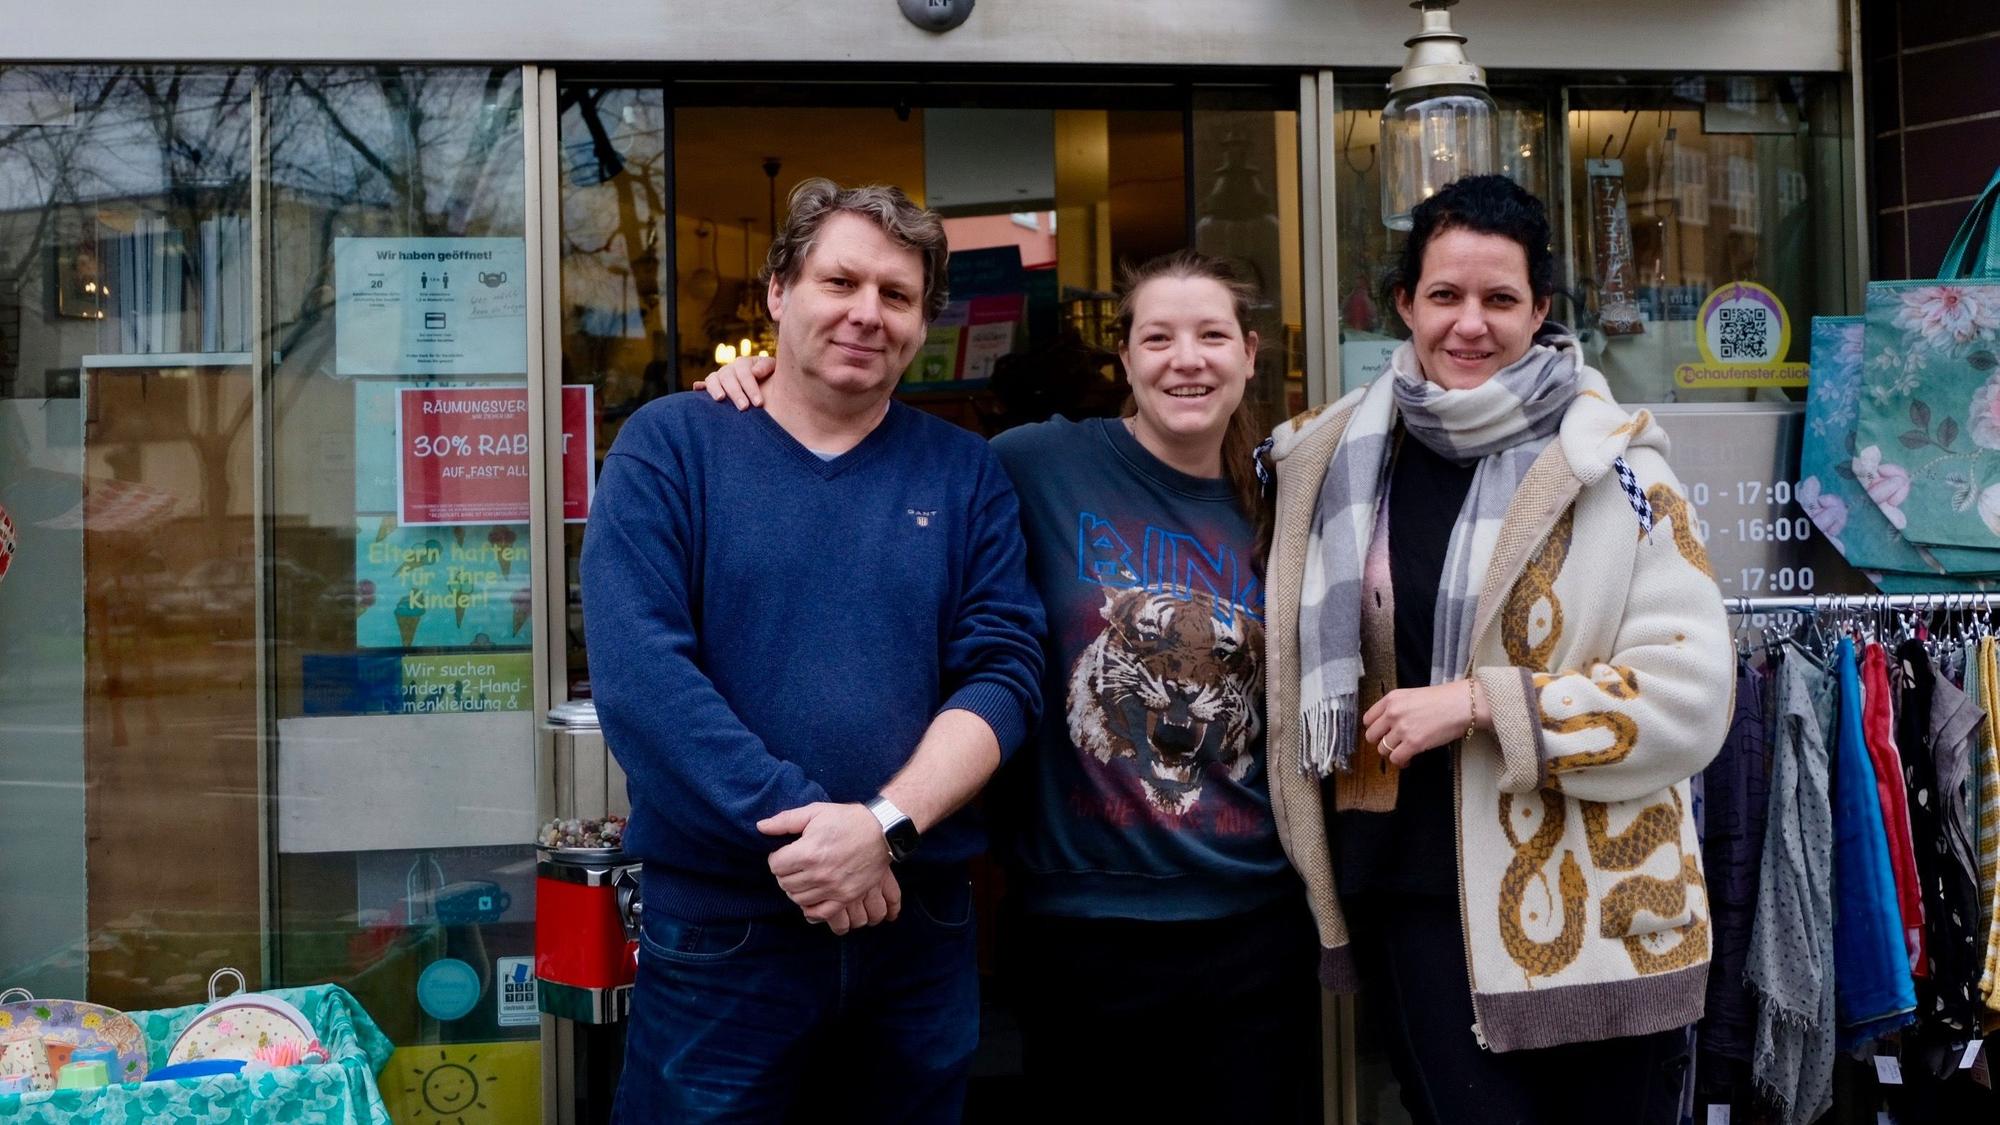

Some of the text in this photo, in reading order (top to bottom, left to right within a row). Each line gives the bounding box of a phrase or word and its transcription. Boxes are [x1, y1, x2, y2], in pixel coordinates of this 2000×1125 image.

[376, 249, 493, 262] Wir haben geöffnet!
[370, 279, 383, 289] 20
[413, 433, 574, 457] 30% RABT
[442, 466, 463, 478] AUF
[1737, 517, 1811, 542] 16:00
[369, 542, 529, 563] Eltern haften
[399, 565, 498, 587] für Ihre
[1740, 566, 1815, 592] 17:00
[409, 590, 488, 609] Kinder!
[404, 661, 496, 678] Wir suchen
[394, 677, 528, 696] ondere 2-Hand-
[506, 693, 518, 709] &
